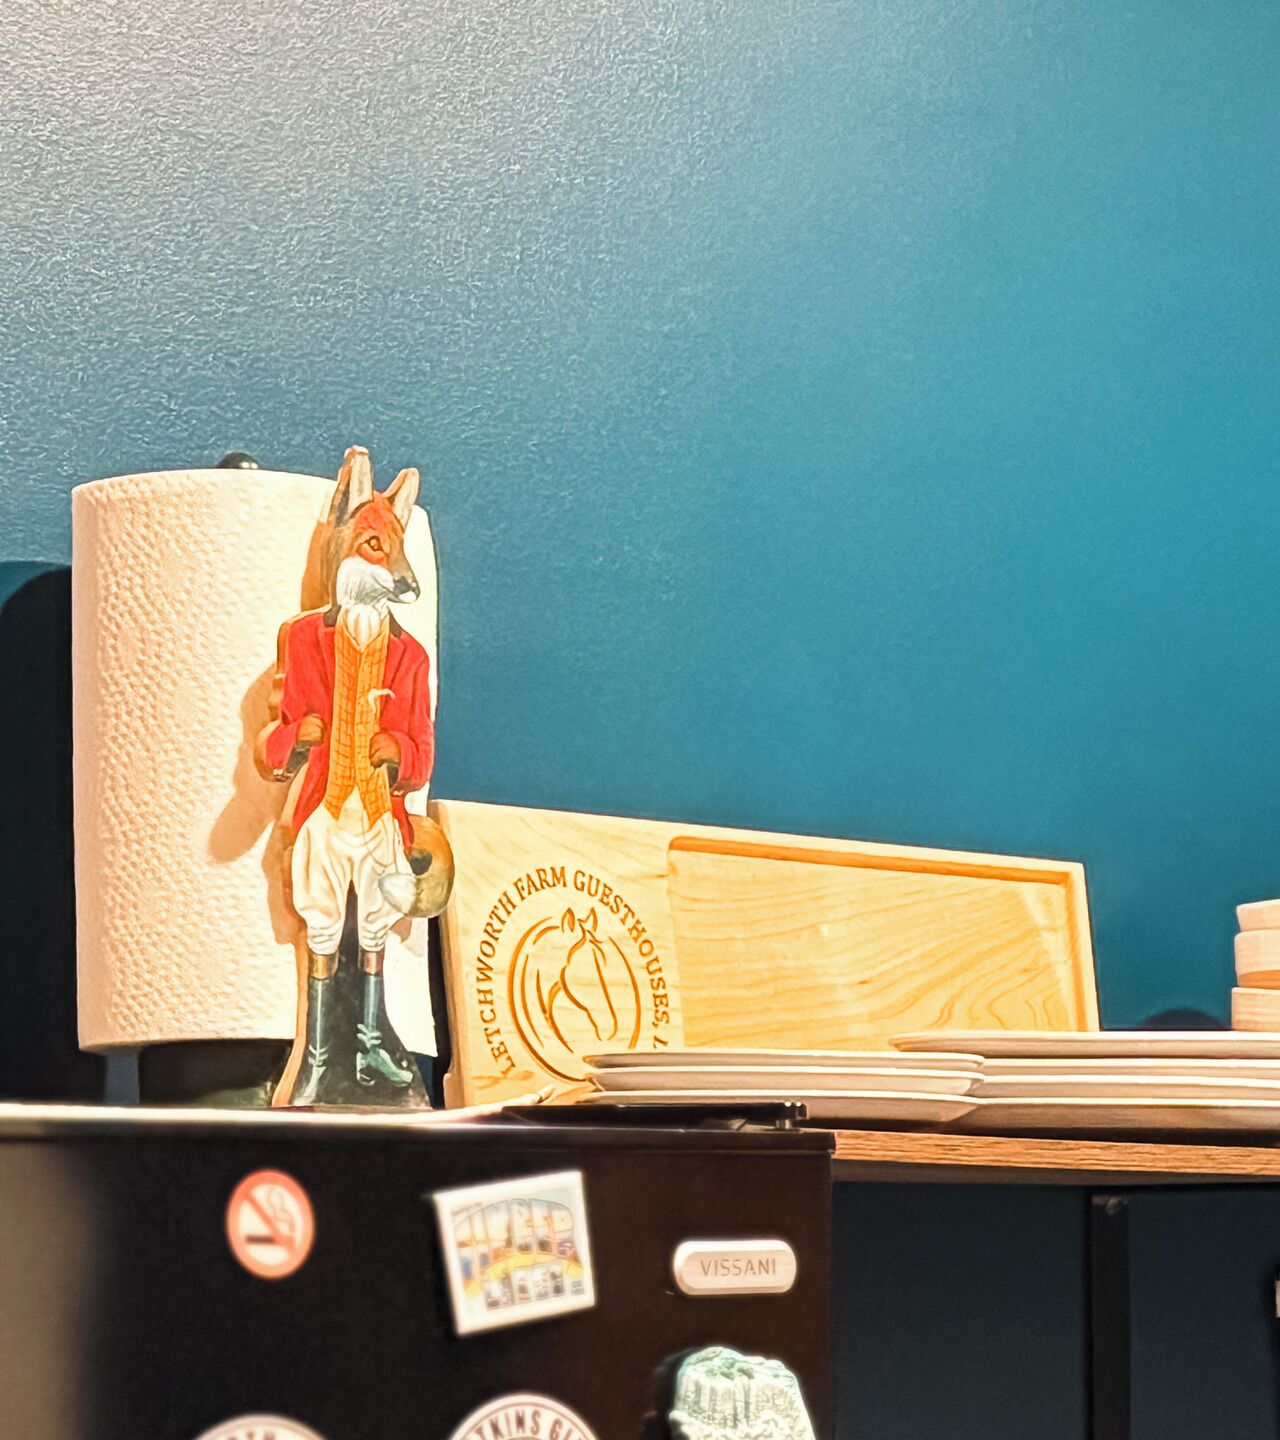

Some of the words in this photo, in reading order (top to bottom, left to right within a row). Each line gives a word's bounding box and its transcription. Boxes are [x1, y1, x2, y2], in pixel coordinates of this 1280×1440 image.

[476, 890, 517, 1075] LETCHWORTH
[513, 866, 568, 901] FARM
[573, 870, 670, 1028] GUESTHOUSES,
[700, 1258, 776, 1277] VISSANI
